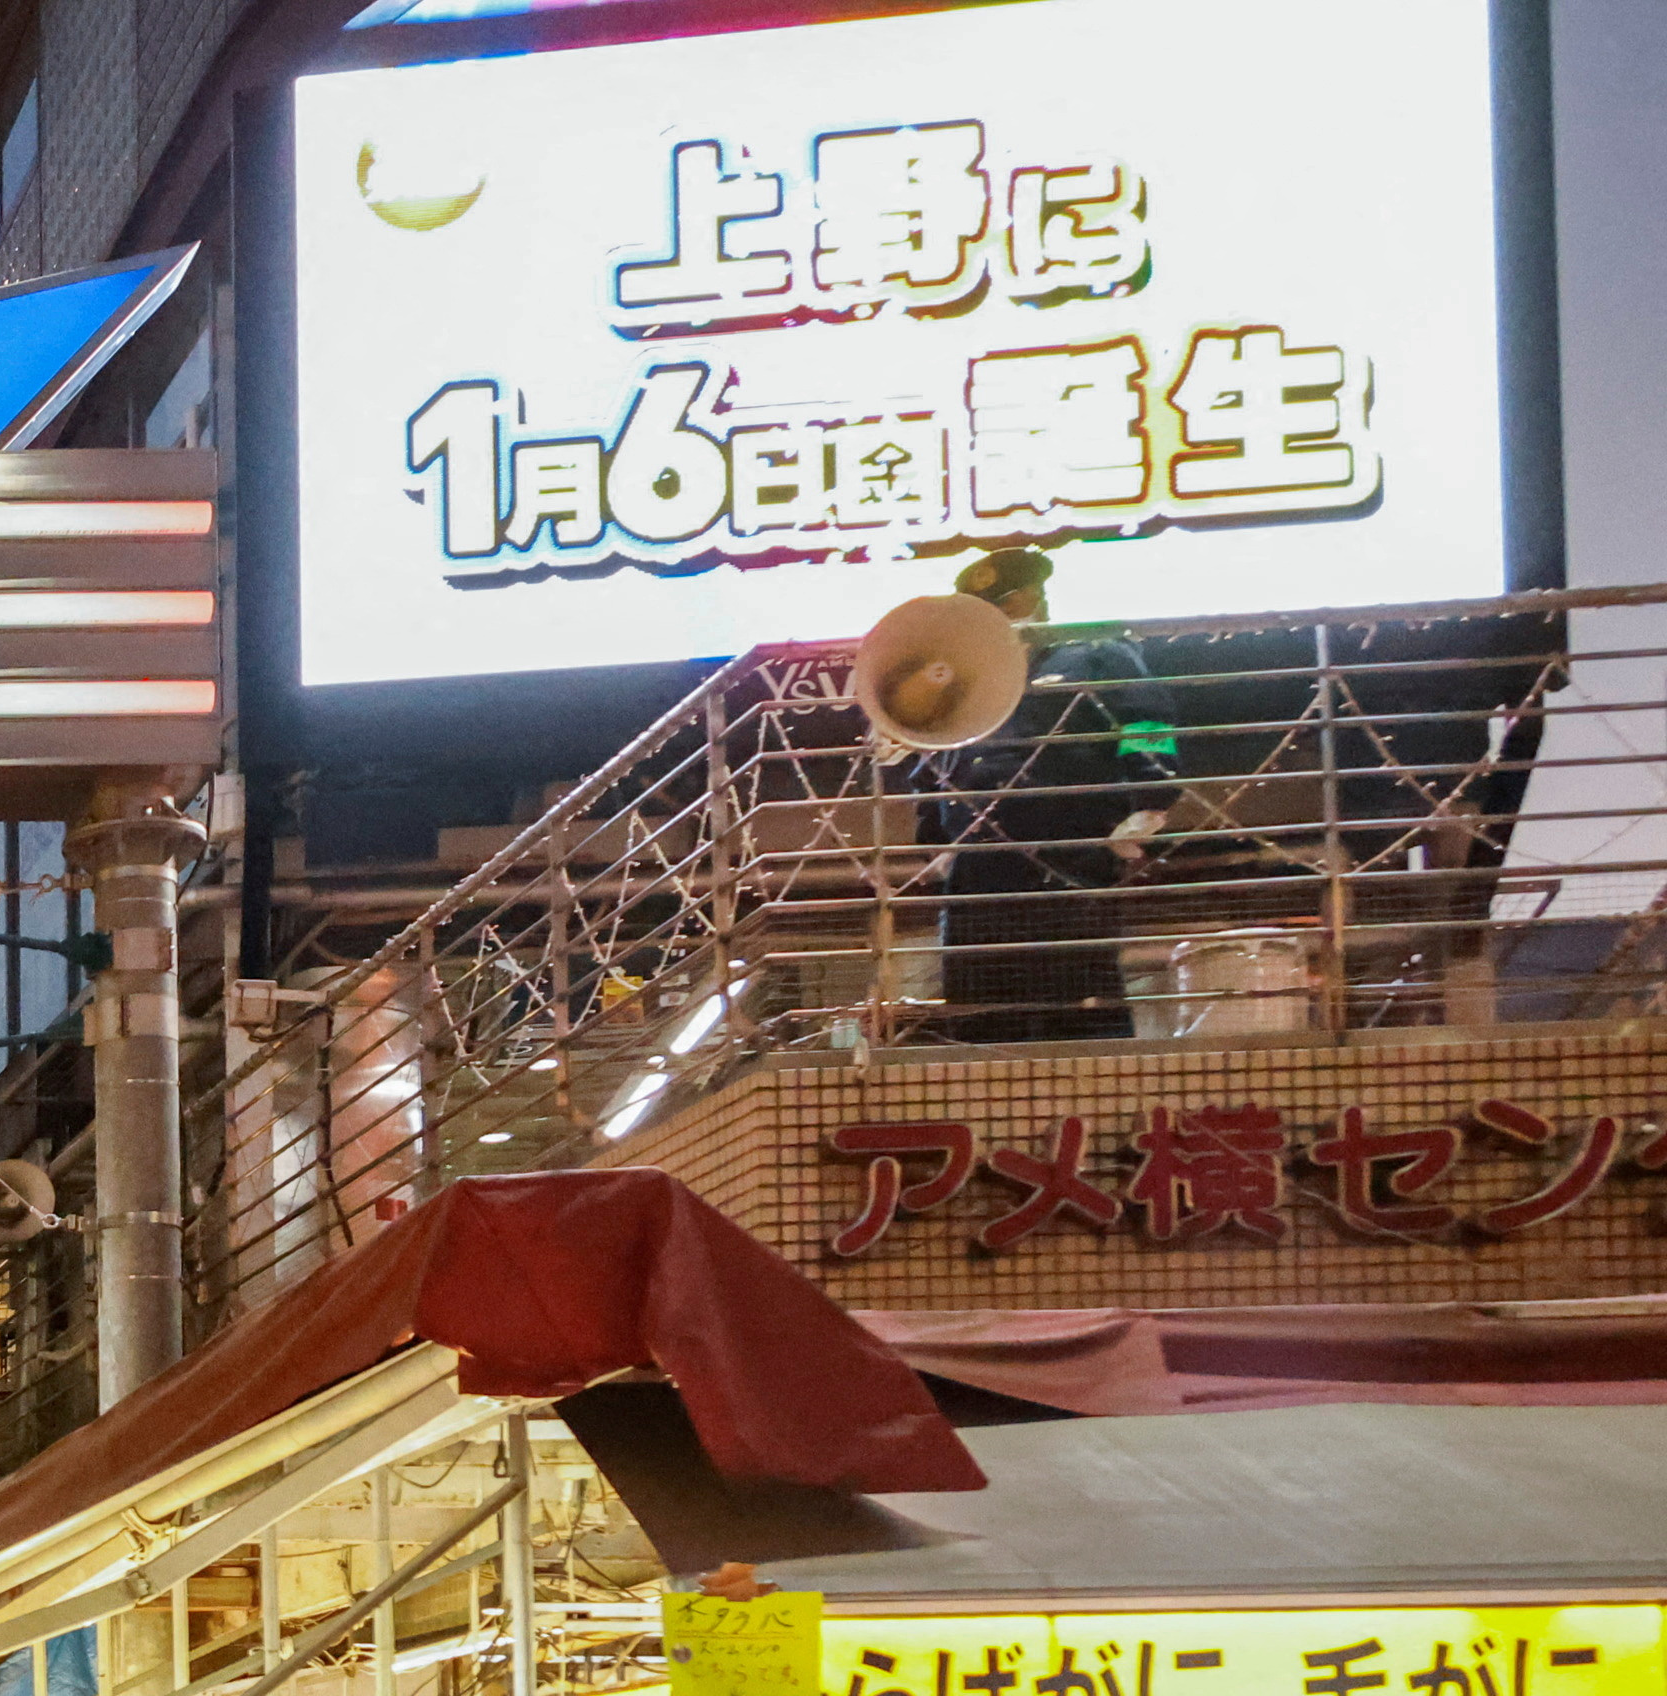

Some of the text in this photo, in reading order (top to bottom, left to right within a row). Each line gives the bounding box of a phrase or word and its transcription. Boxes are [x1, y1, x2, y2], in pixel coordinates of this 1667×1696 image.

[615, 120, 1151, 325] 上野に
[831, 1098, 1667, 1258] アメ横セン
